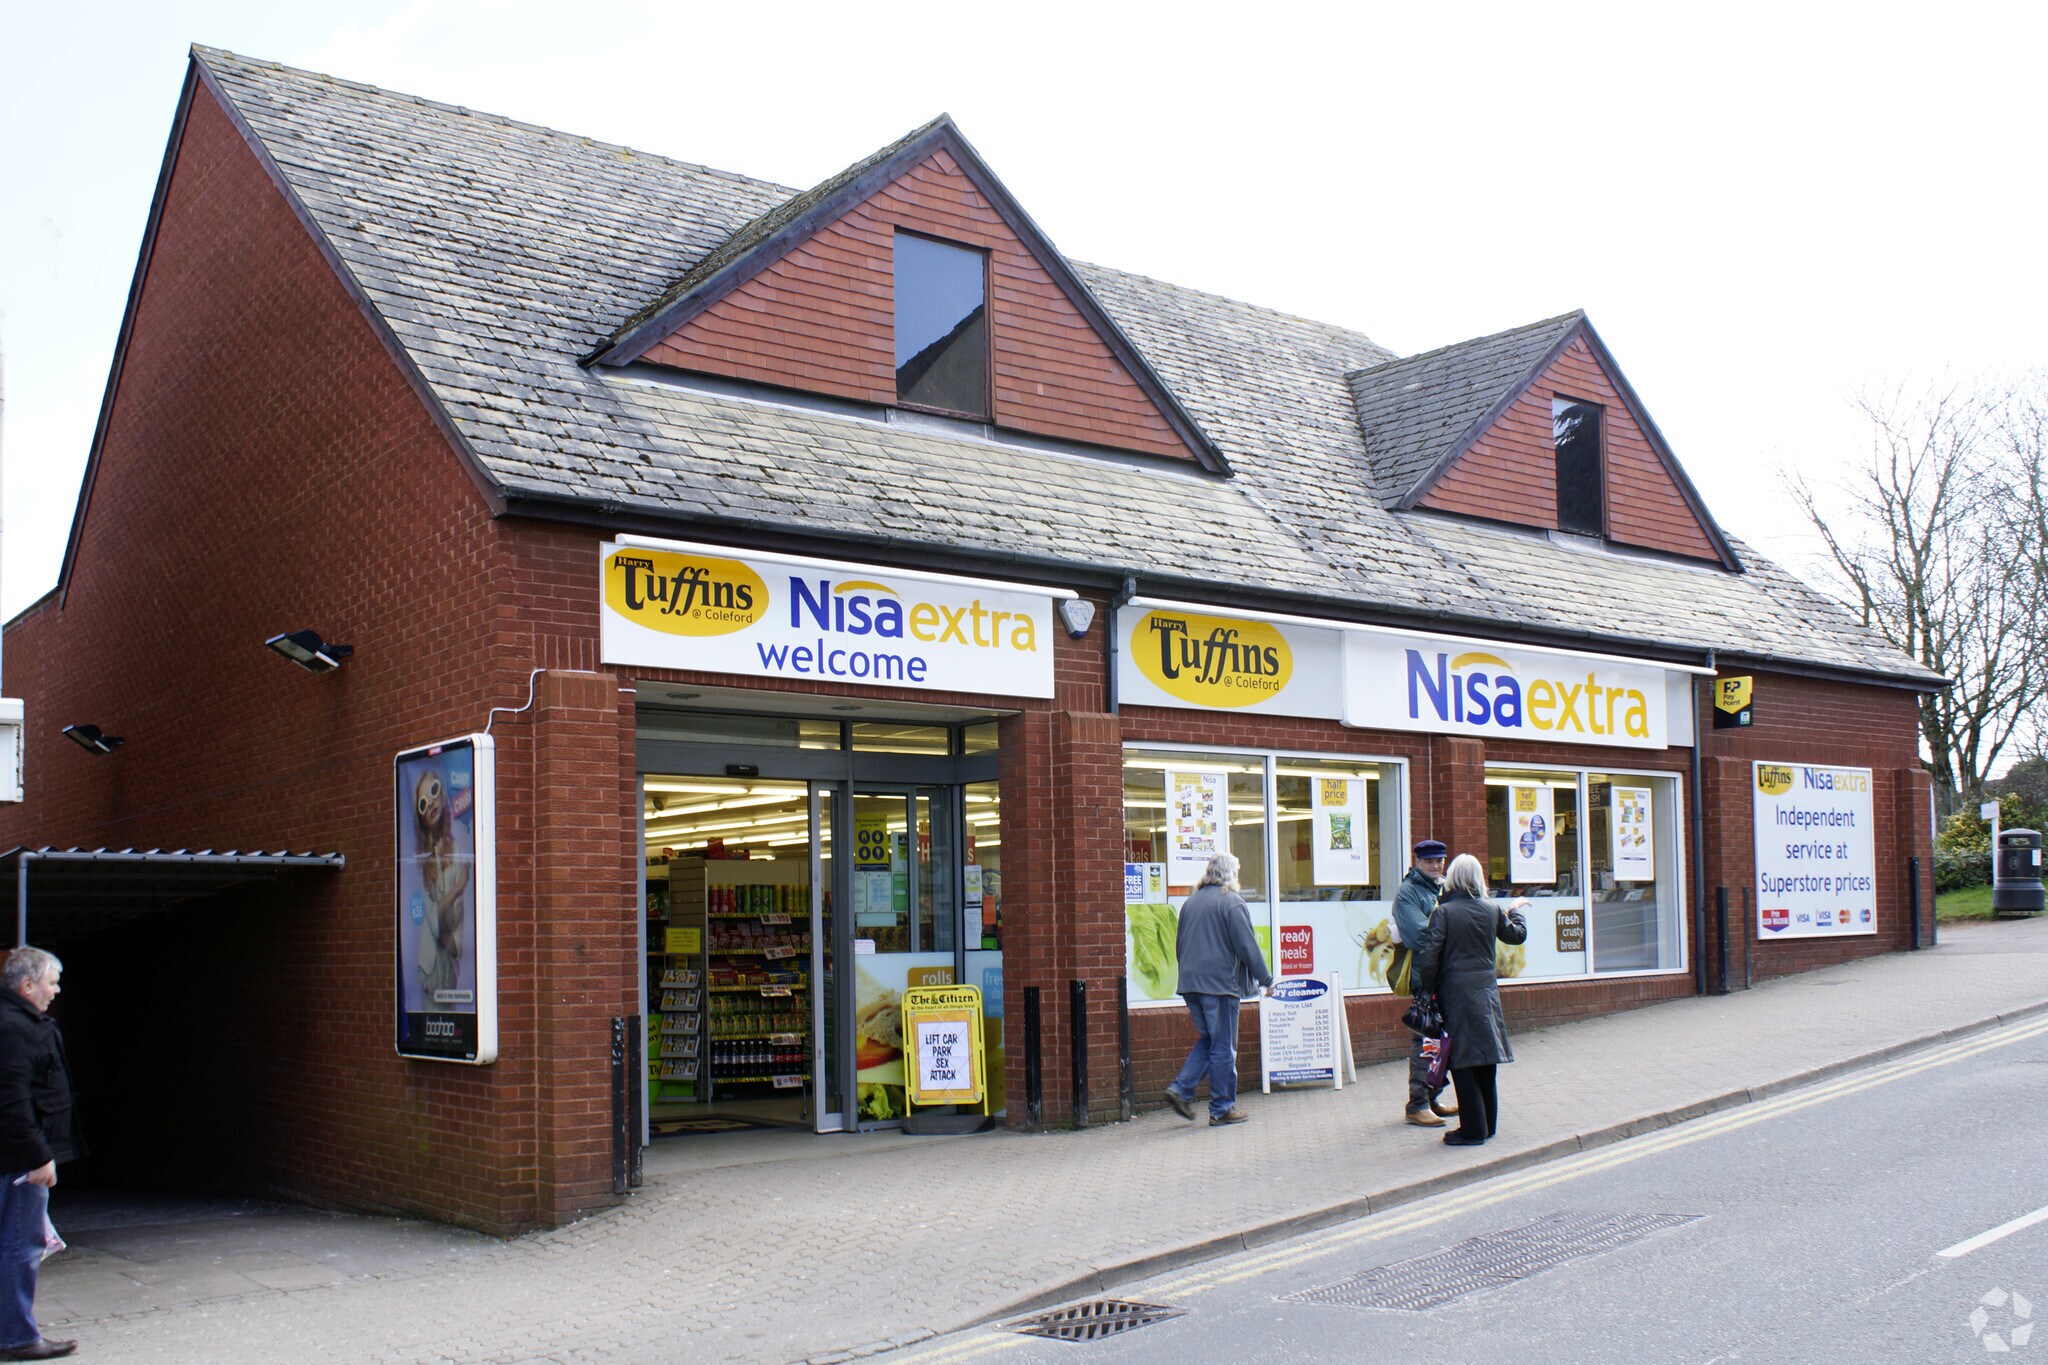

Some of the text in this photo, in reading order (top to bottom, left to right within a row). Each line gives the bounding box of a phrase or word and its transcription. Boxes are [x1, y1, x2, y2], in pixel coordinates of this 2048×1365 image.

[617, 557, 651, 569] Harry
[614, 556, 753, 616] Tuffins
[692, 608, 753, 624] @ Coleford
[1153, 618, 1184, 631] Harry
[1150, 616, 1279, 685] Tuffins
[757, 638, 928, 682] welcome
[1224, 676, 1280, 691] @ Coleford
[1203, 776, 1217, 784] Nisa
[1757, 765, 1791, 788] Tuffins
[1326, 779, 1342, 789] half
[1324, 790, 1345, 800] price
[1520, 800, 1534, 808] price
[1776, 804, 1855, 831] Independent
[1125, 847, 1149, 862] Deals
[1786, 840, 1848, 859] service at
[1125, 875, 1142, 884] FREE
[1761, 872, 1871, 898] Superstore prices
[1125, 885, 1142, 894] CASH
[1557, 912, 1579, 925] fresh
[1797, 914, 1810, 923] VISA
[1818, 911, 1831, 920] VISA
[1280, 929, 1310, 945] ready
[1562, 927, 1584, 938] crusty
[1560, 939, 1580, 950] bread
[1280, 945, 1307, 959] meals
[922, 970, 952, 985] rolls
[1277, 981, 1307, 989] midland
[1288, 988, 1324, 997] cleaners
[911, 994, 973, 1005] The Citizen
[426, 1016, 455, 1036] boohoo
[925, 1033, 958, 1044] LIFT CAR
[932, 1046, 952, 1057] PARK
[936, 1058, 949, 1068] SEX
[930, 1070, 956, 1081] ATTACK
